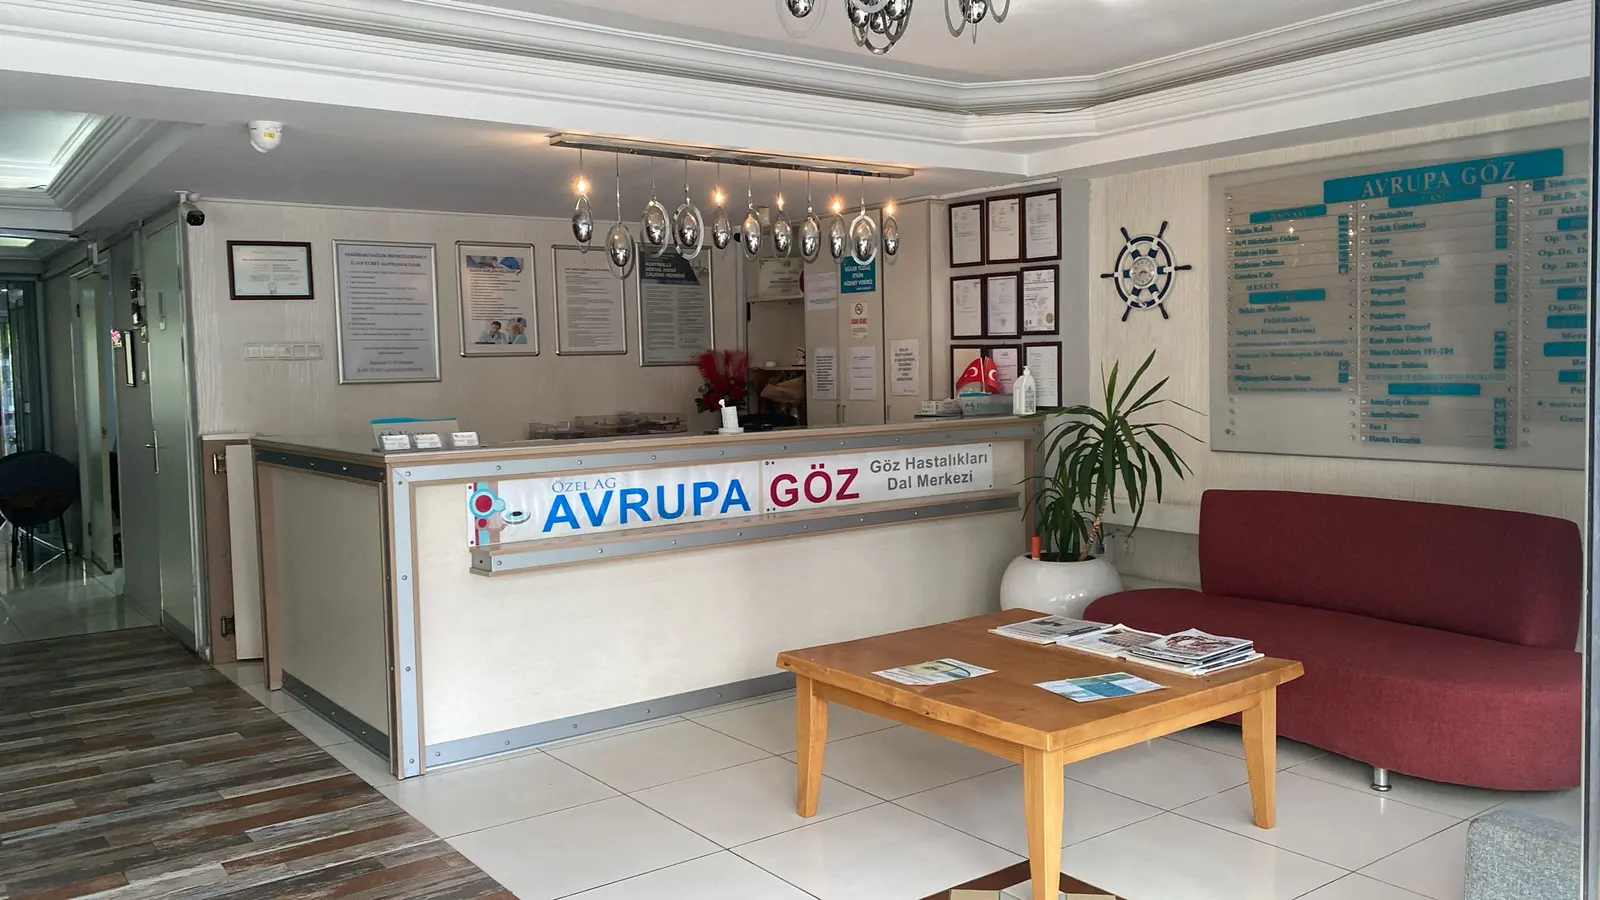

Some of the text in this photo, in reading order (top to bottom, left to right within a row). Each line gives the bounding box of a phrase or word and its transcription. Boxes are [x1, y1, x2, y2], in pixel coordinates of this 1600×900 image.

[1361, 160, 1517, 198] AVRUPA GÖZ
[870, 453, 988, 473] Göz Hastalıkları
[552, 477, 617, 493] ÖZEL AG
[887, 470, 973, 490] Dal Merkezi
[543, 463, 860, 533] AVRUPA GÖZ
